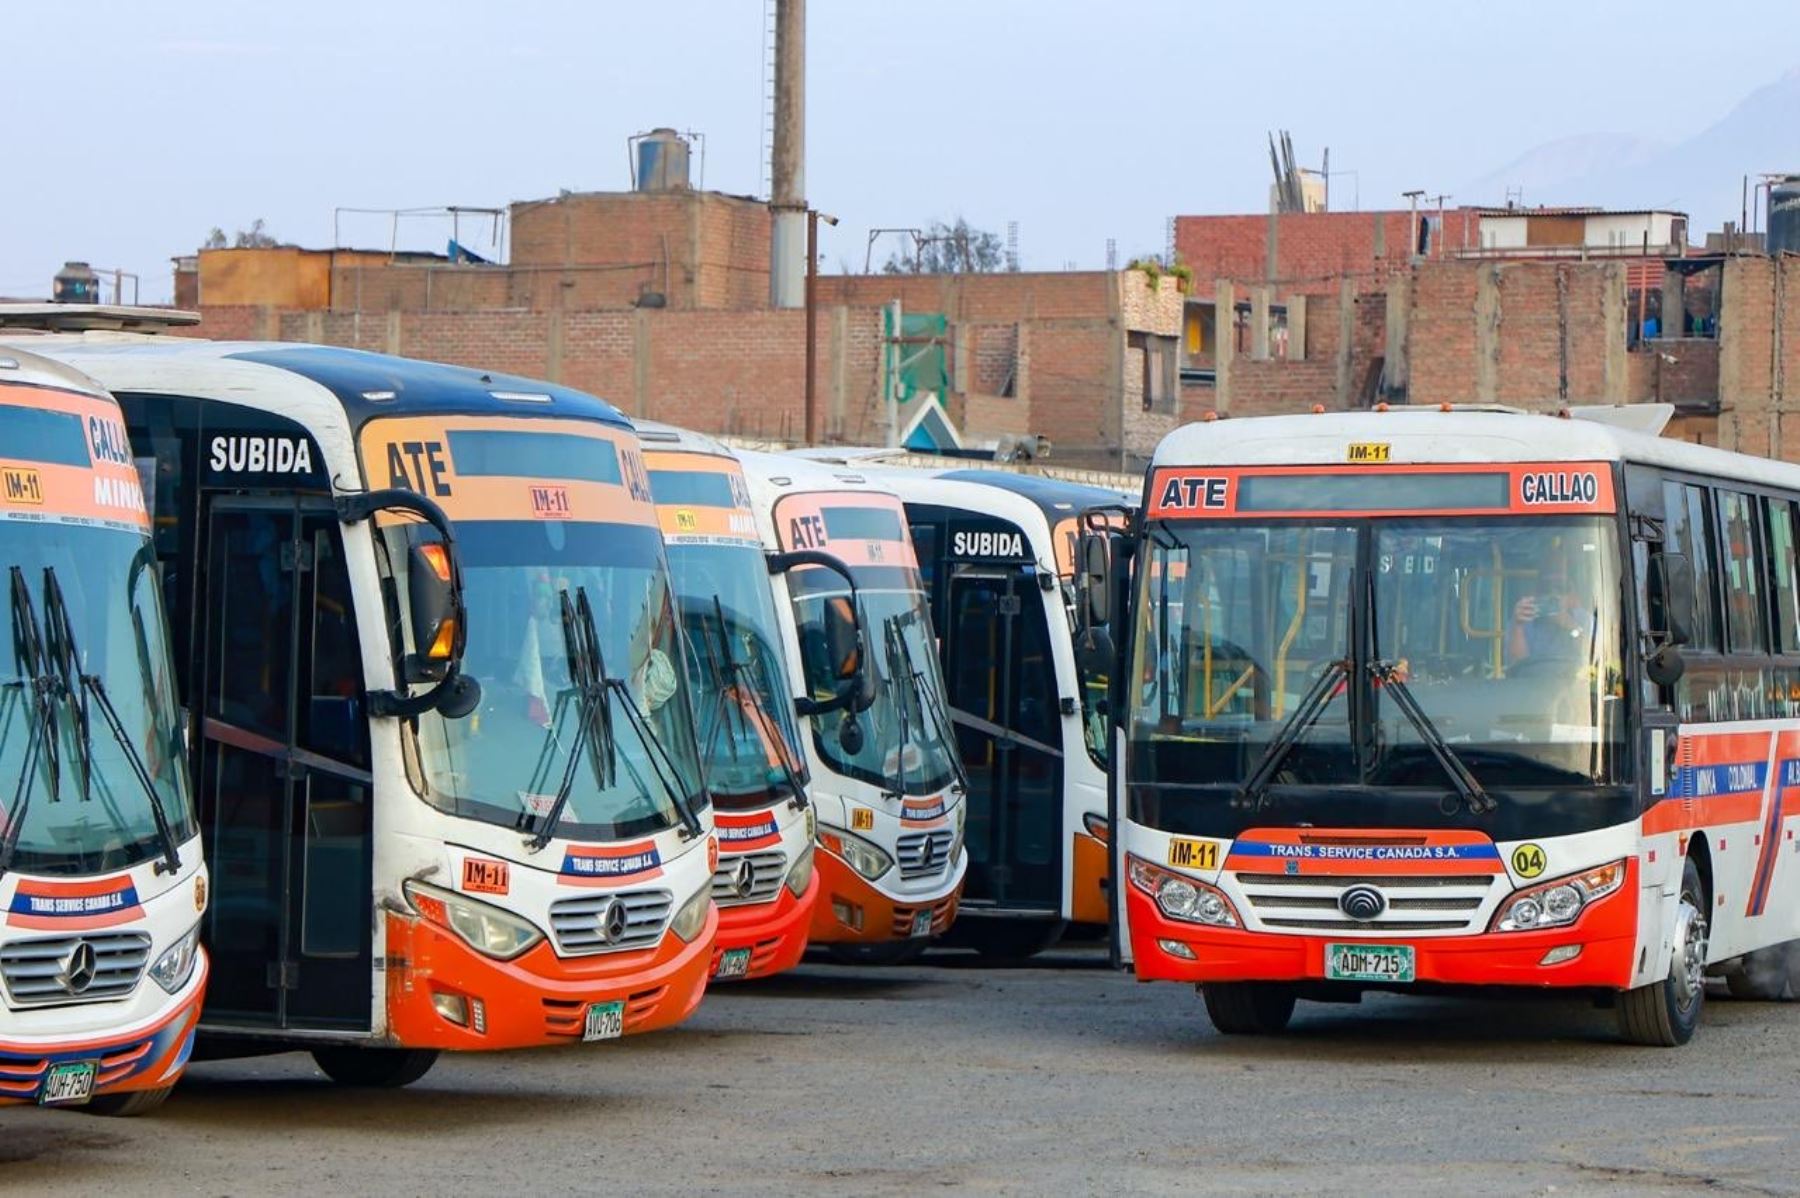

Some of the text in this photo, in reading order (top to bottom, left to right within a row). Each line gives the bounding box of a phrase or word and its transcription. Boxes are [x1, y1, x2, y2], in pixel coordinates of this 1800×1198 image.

[210, 436, 313, 474] SUBIDA
[1350, 446, 1390, 459] IM-11
[387, 441, 453, 497] ATE
[5, 471, 40, 499] IM-11
[1160, 476, 1228, 509] ATE
[1521, 472, 1598, 506] CALLAO
[532, 488, 569, 511] IM-11
[789, 514, 826, 551] ATE
[954, 531, 1023, 557] SUBIDA
[1171, 840, 1217, 868] IM-11
[1269, 844, 1460, 860] TRANS. SERVICE CANADA S.A.
[1515, 850, 1543, 872] 04
[467, 861, 506, 886] IM-11
[594, 857, 620, 873] SERVICE
[55, 897, 84, 912] SERVICE
[1341, 953, 1400, 974] ADM-715
